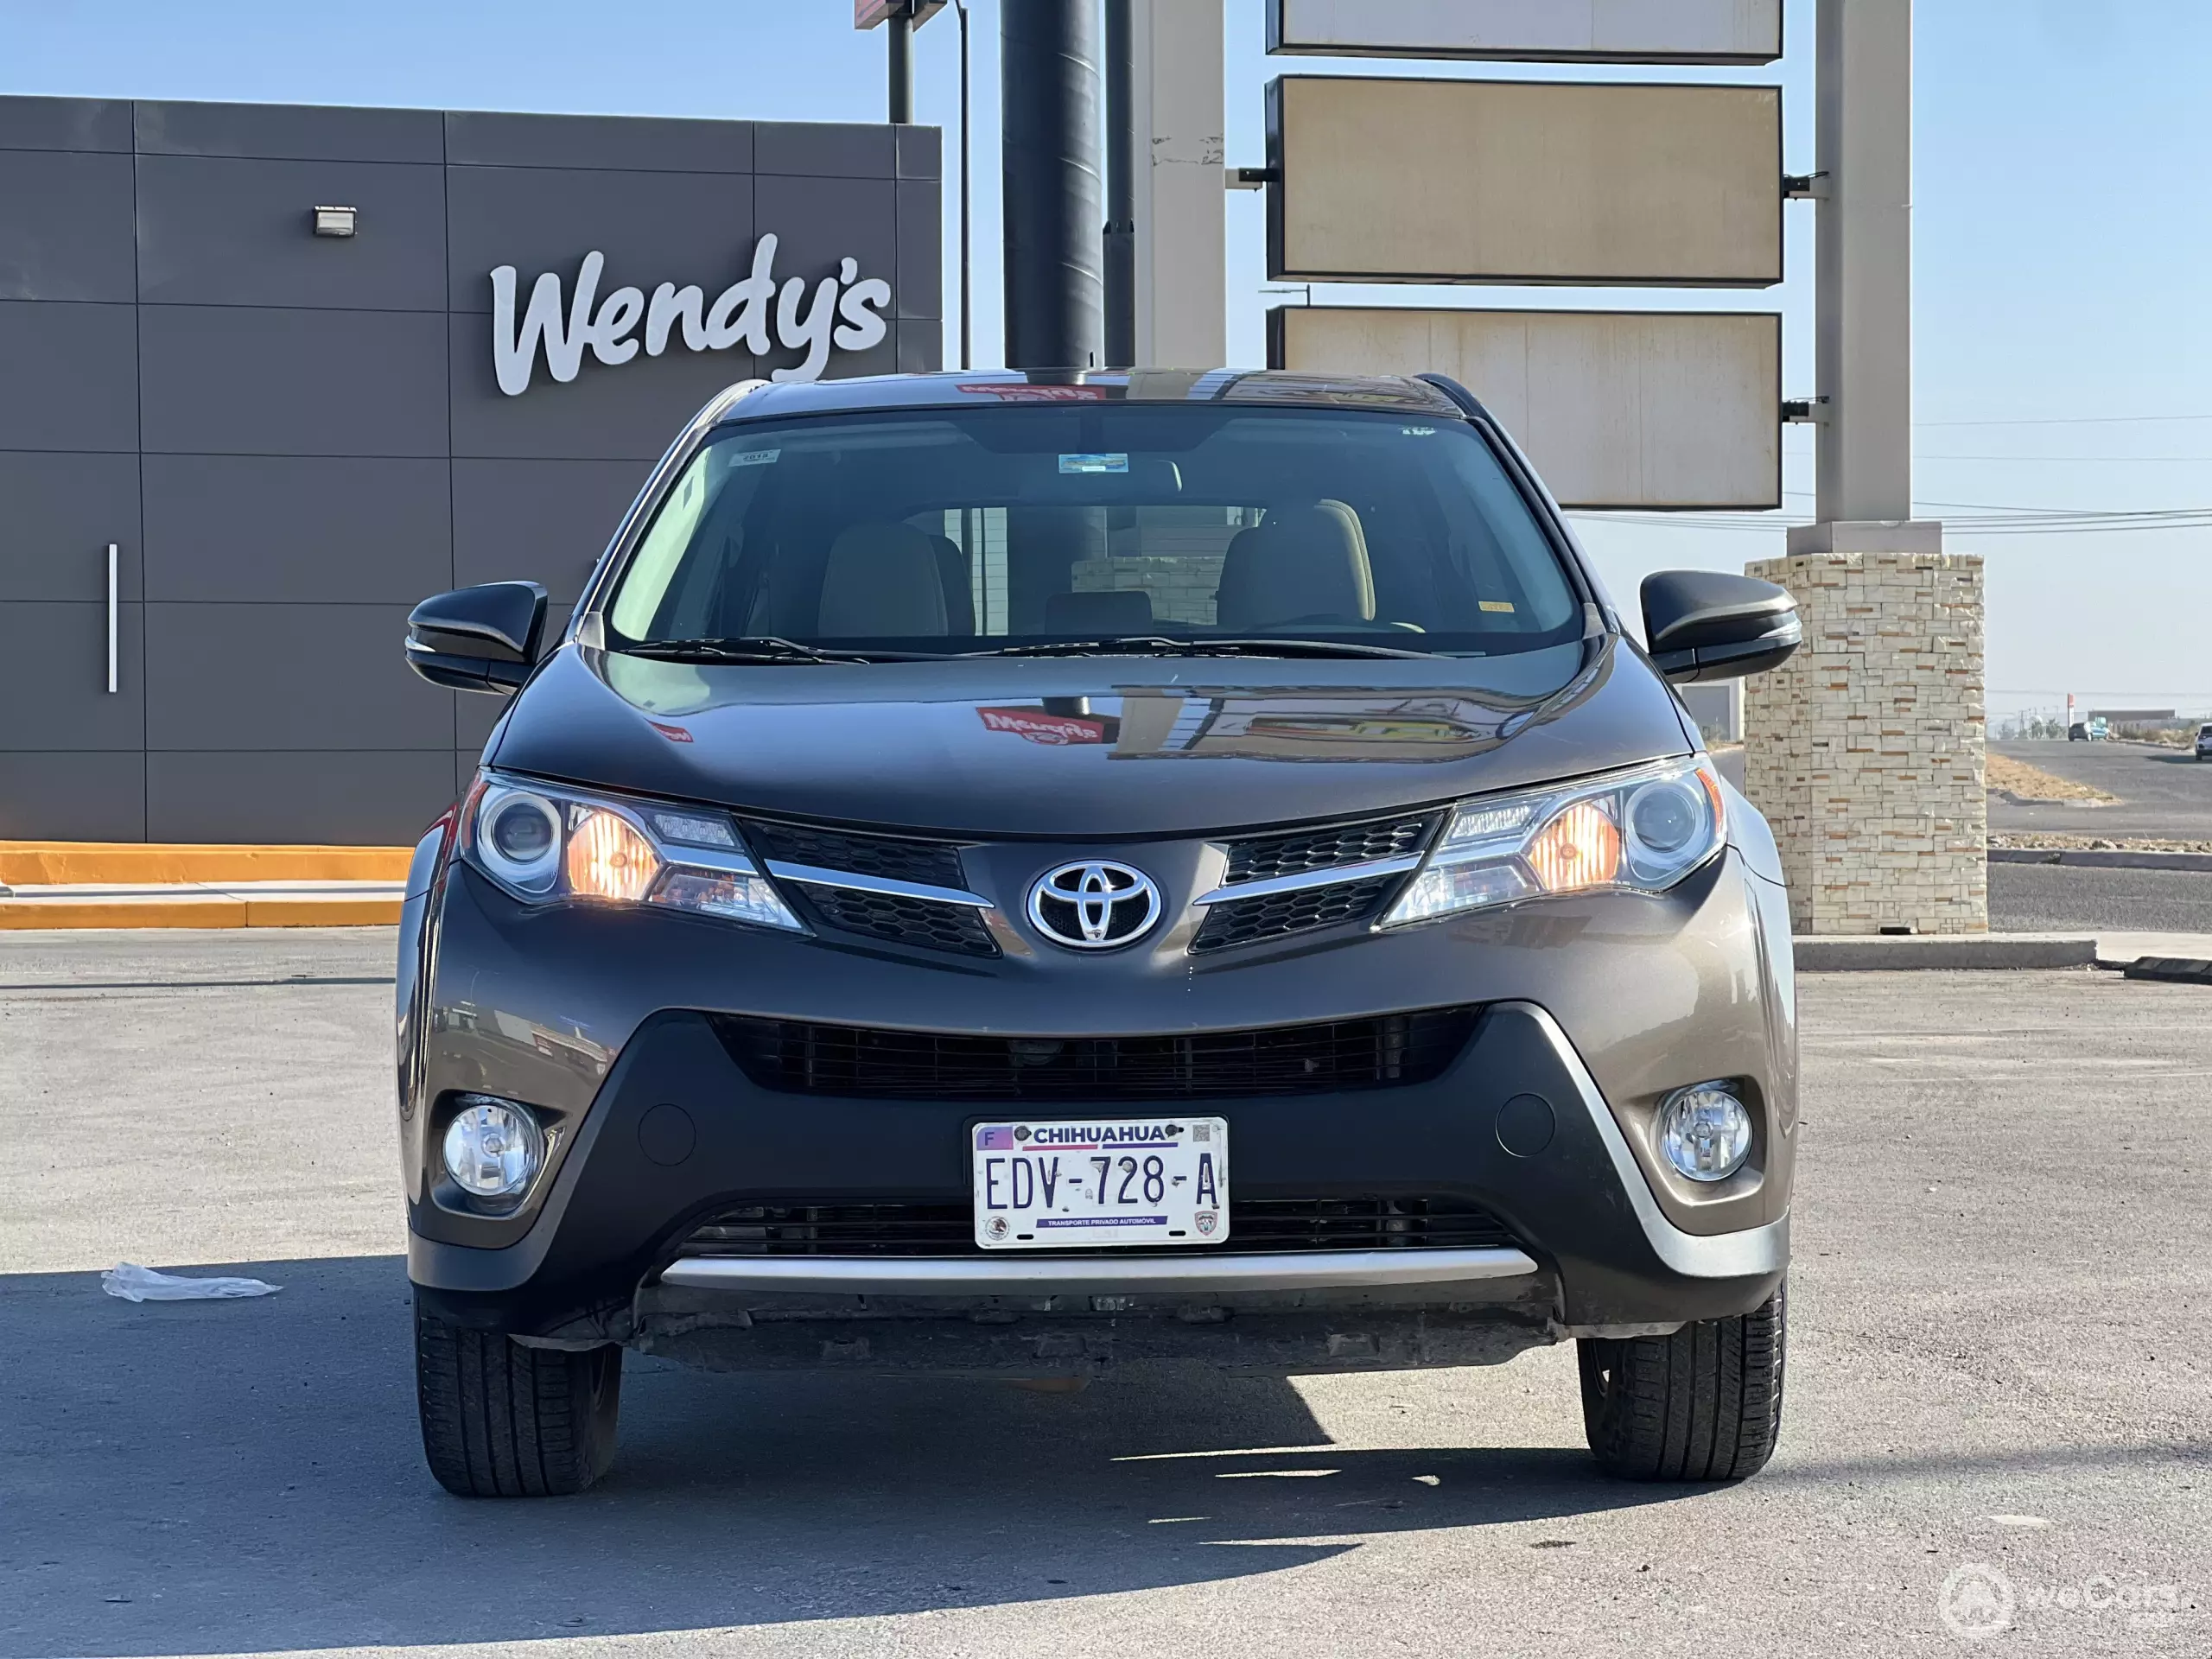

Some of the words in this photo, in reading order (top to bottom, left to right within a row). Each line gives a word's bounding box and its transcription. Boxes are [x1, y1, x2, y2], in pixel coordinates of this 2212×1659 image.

[490, 233, 892, 396] Wendy's
[984, 1131, 995, 1147] F
[1033, 1126, 1166, 1144] CHIHUAHUA
[986, 1153, 1217, 1210] EDV-728-A
